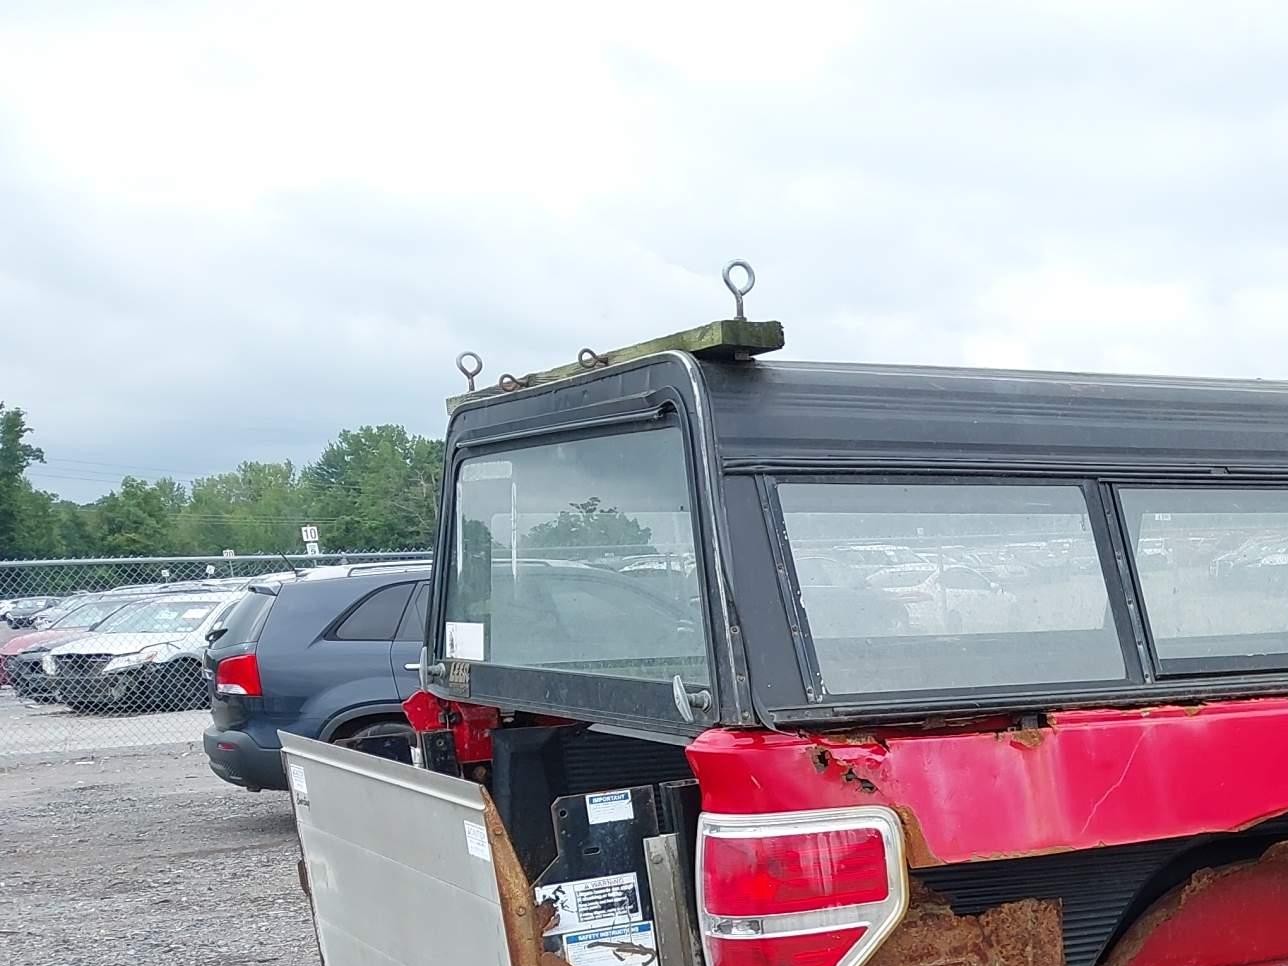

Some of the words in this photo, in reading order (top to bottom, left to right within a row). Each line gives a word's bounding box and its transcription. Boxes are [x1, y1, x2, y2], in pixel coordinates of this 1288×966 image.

[303, 528, 317, 540] 10
[592, 793, 625, 804] IMPORTANT
[590, 877, 625, 889] WARNING
[578, 932, 600, 942] SAFETY
